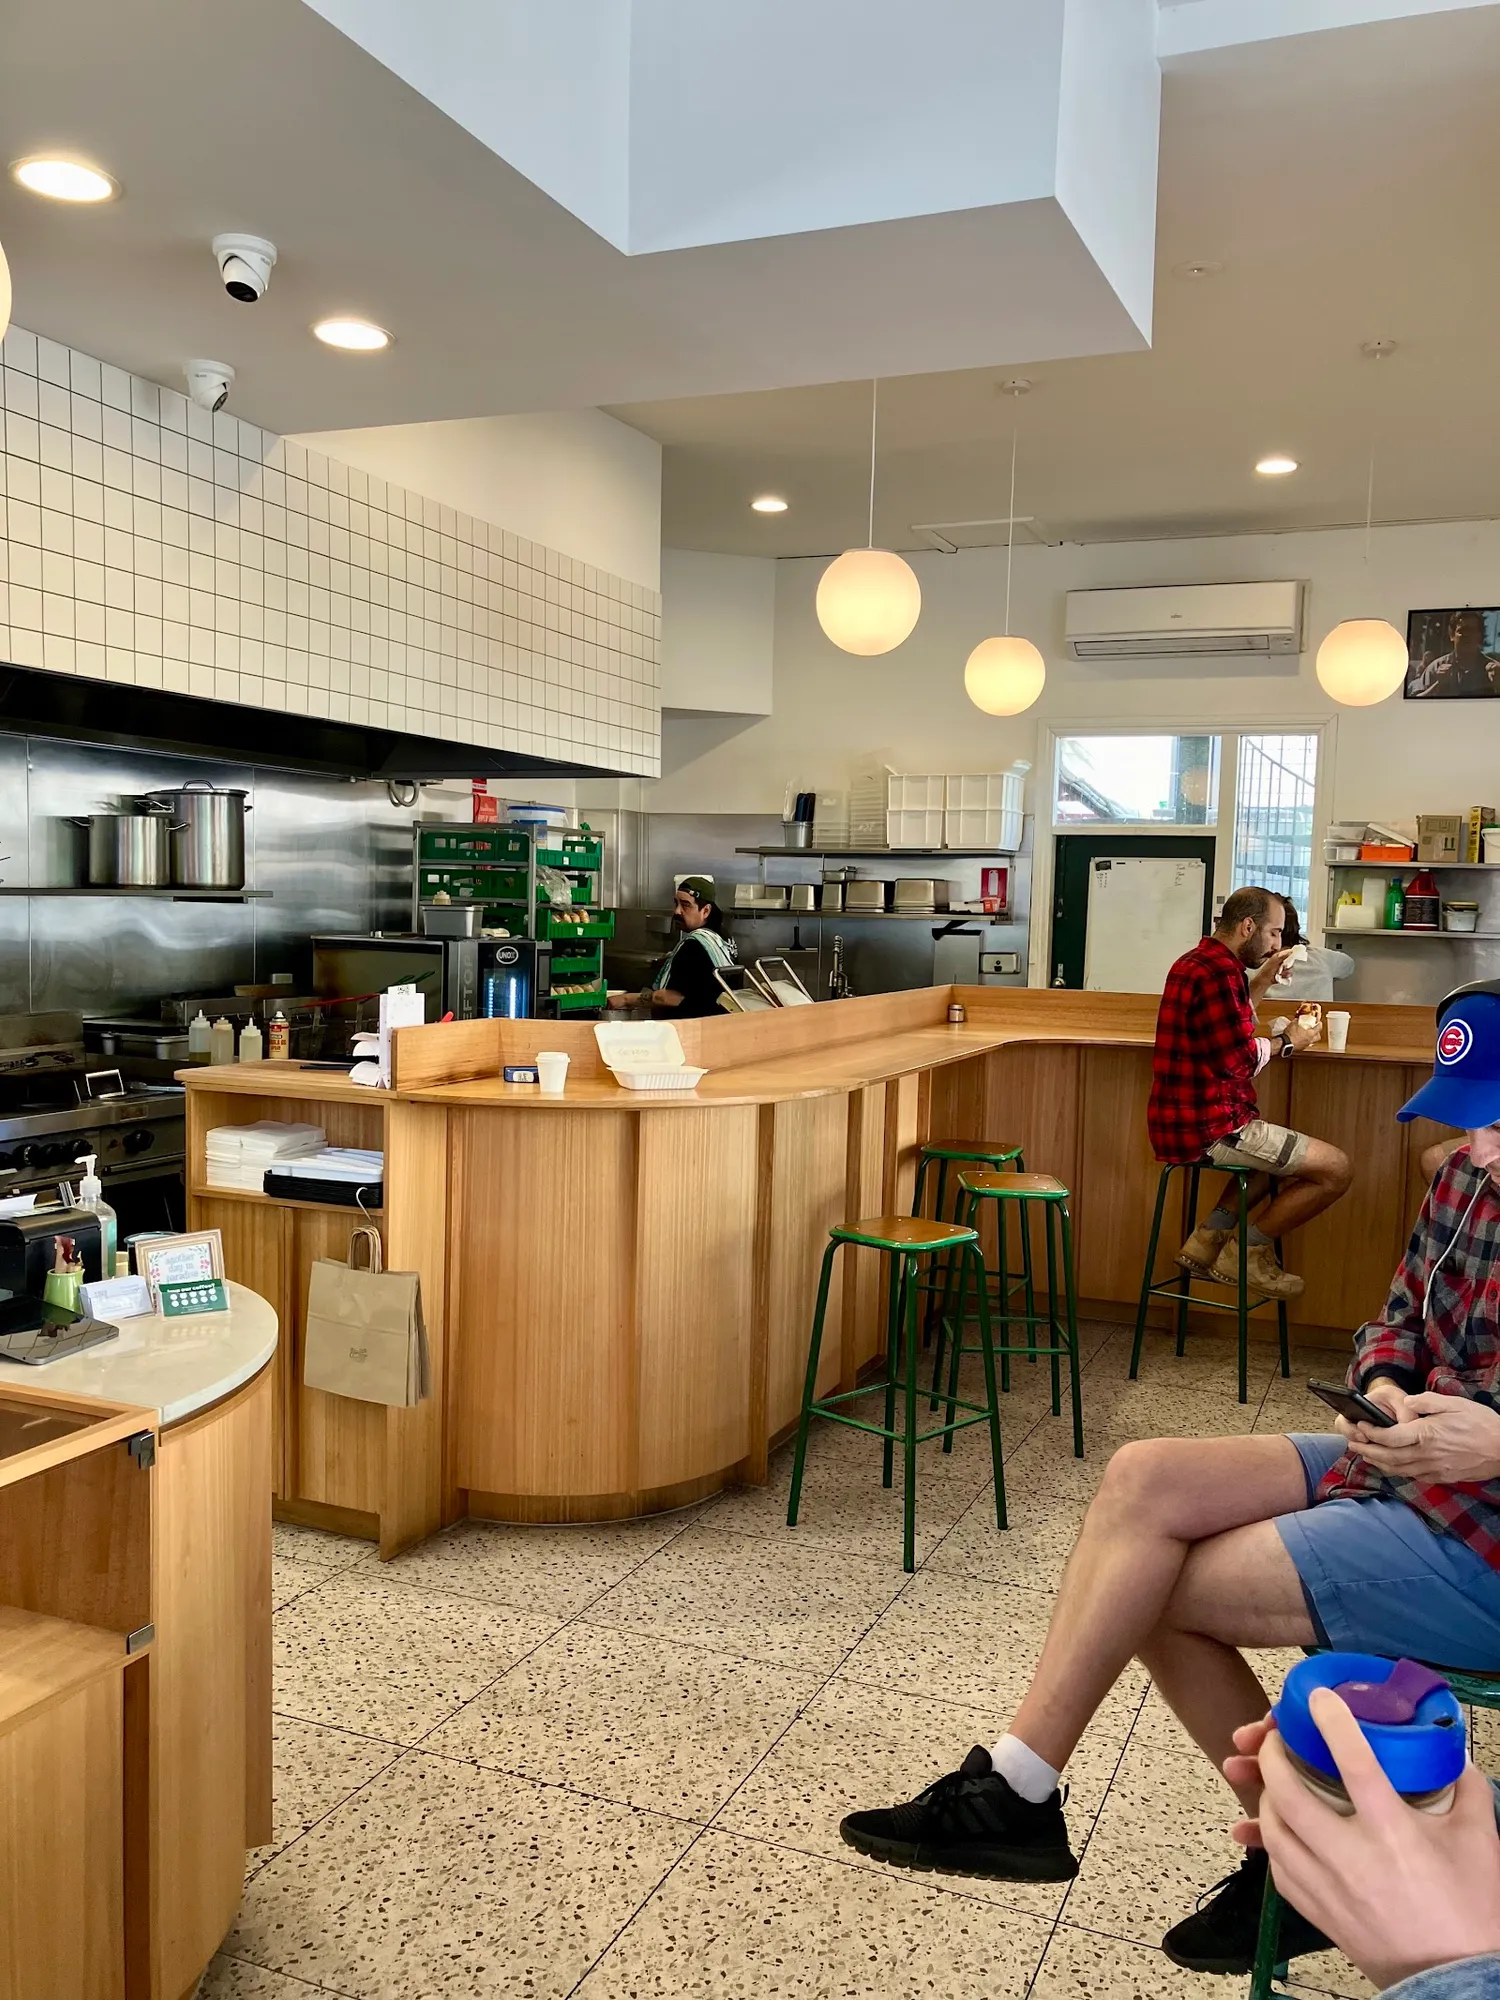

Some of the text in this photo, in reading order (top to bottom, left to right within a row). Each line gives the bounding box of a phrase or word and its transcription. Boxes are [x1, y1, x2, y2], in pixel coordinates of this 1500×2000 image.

[166, 1252, 195, 1264] another
[168, 1262, 195, 1274] day in
[166, 1270, 199, 1284] paradise
